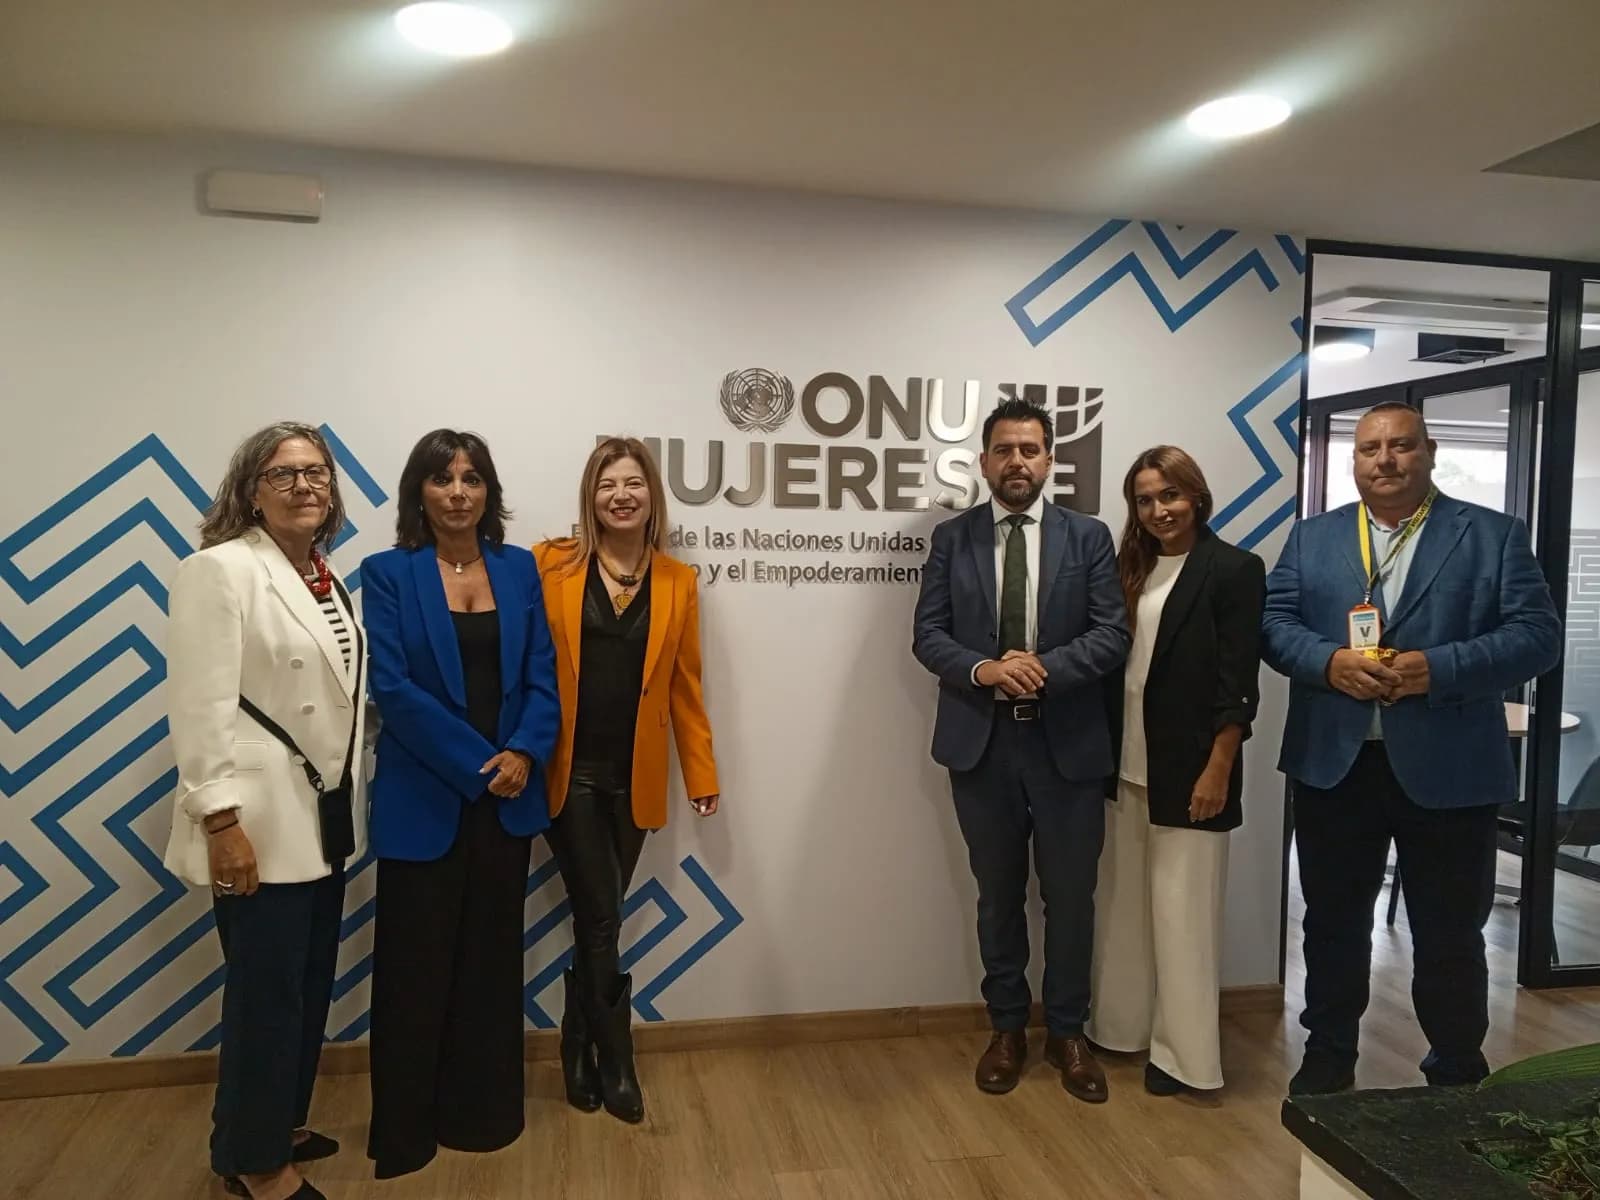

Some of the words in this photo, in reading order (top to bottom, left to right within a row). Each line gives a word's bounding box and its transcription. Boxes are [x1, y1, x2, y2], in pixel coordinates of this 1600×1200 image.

[801, 372, 980, 443] ONU
[669, 524, 698, 547] de
[704, 525, 736, 548] las
[742, 528, 844, 551] Naciones
[850, 531, 925, 552] Unidas
[706, 563, 721, 585] y
[727, 558, 747, 581] el
[753, 560, 926, 586] Empoderamient
[1359, 626, 1371, 638] V
